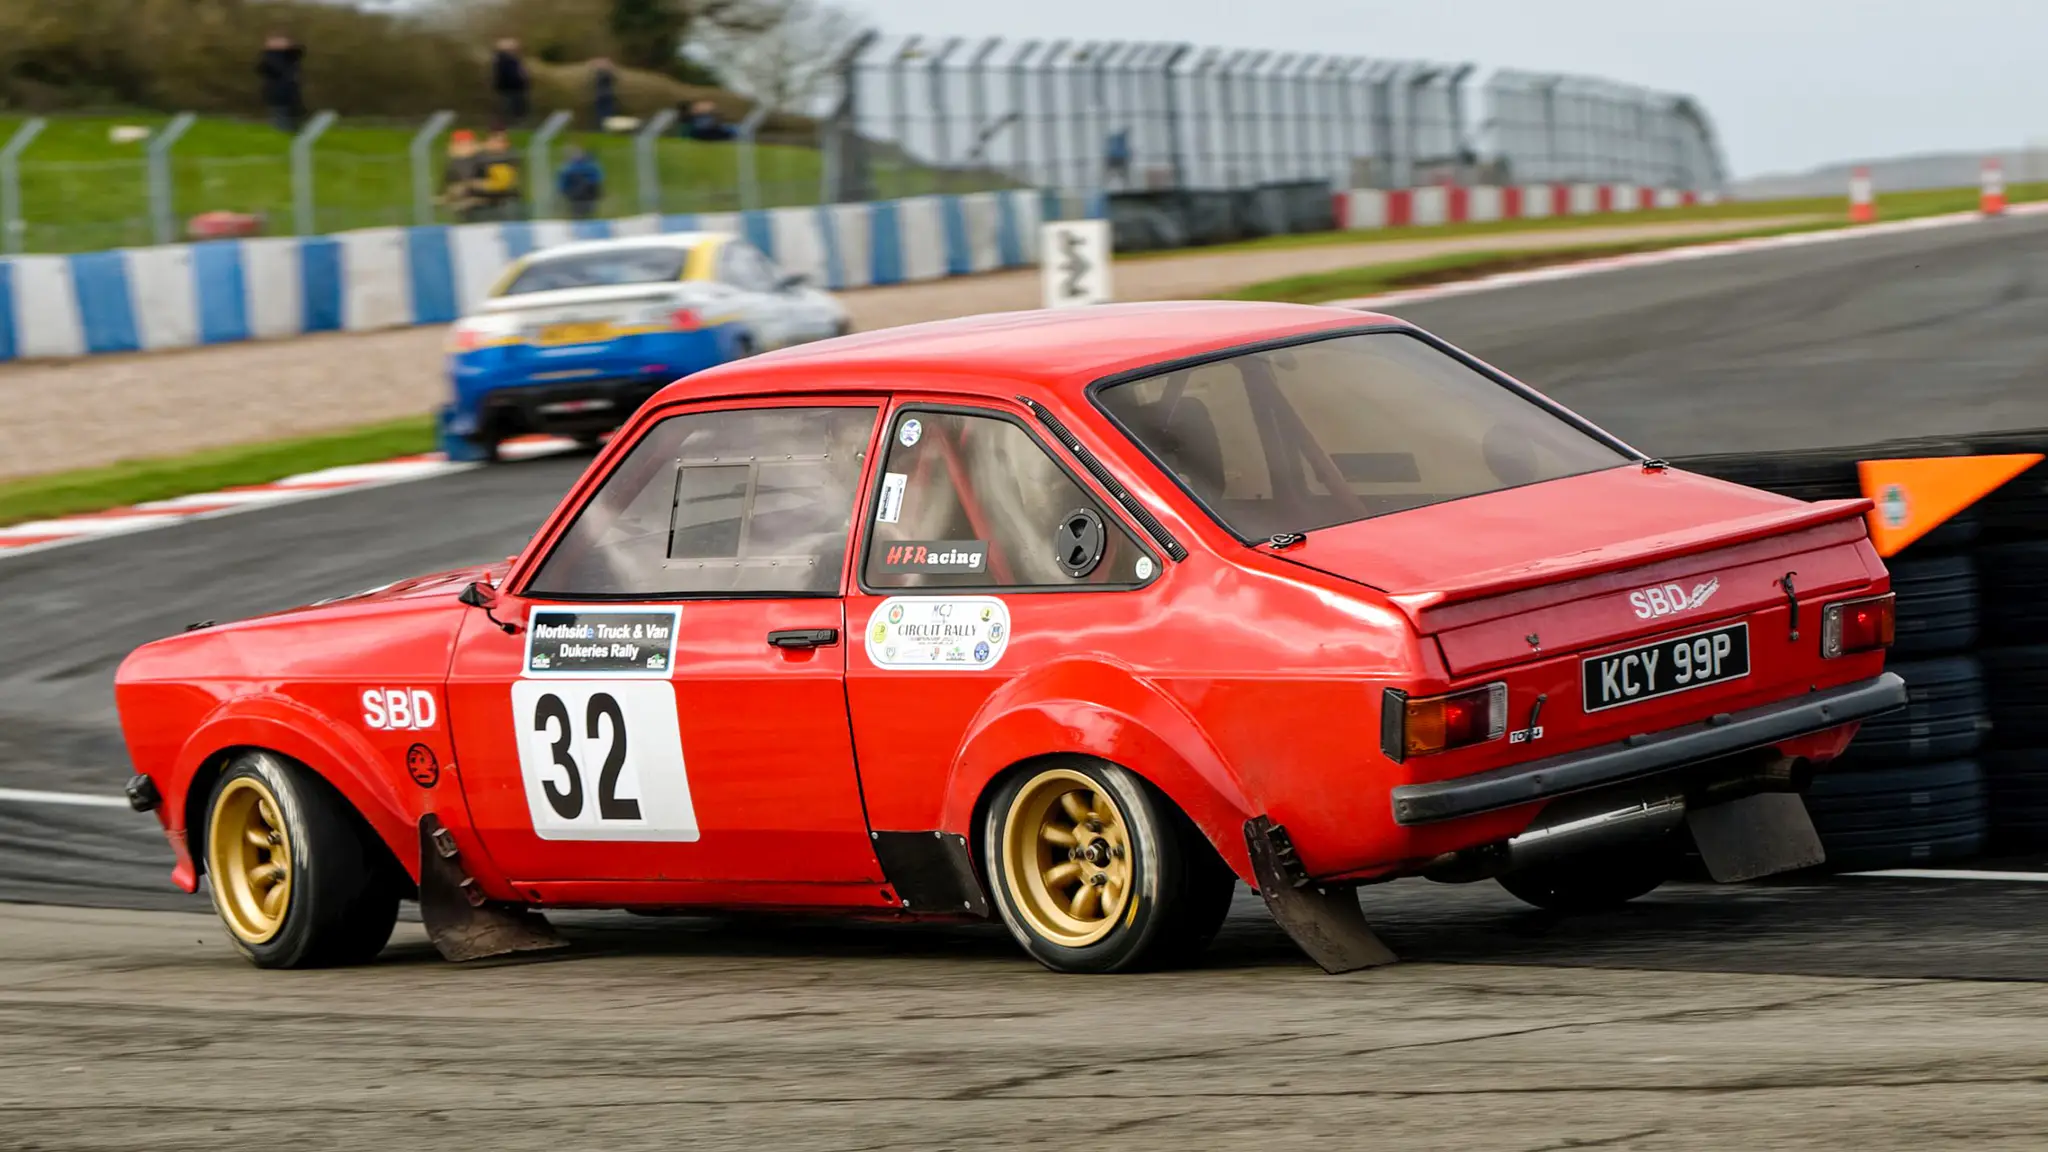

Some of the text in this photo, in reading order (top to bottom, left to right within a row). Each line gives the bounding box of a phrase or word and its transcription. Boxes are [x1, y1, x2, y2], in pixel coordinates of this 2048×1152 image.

[886, 545, 982, 567] HFRacing
[1629, 584, 1688, 619] SBD
[536, 623, 669, 639] Northside Truck & Van
[897, 624, 977, 637] CIRCUIT RALLY
[560, 643, 640, 661] Dukeries Rally
[1601, 633, 1732, 702] KCY 99P
[362, 687, 437, 730] SBD
[534, 692, 643, 820] 32
